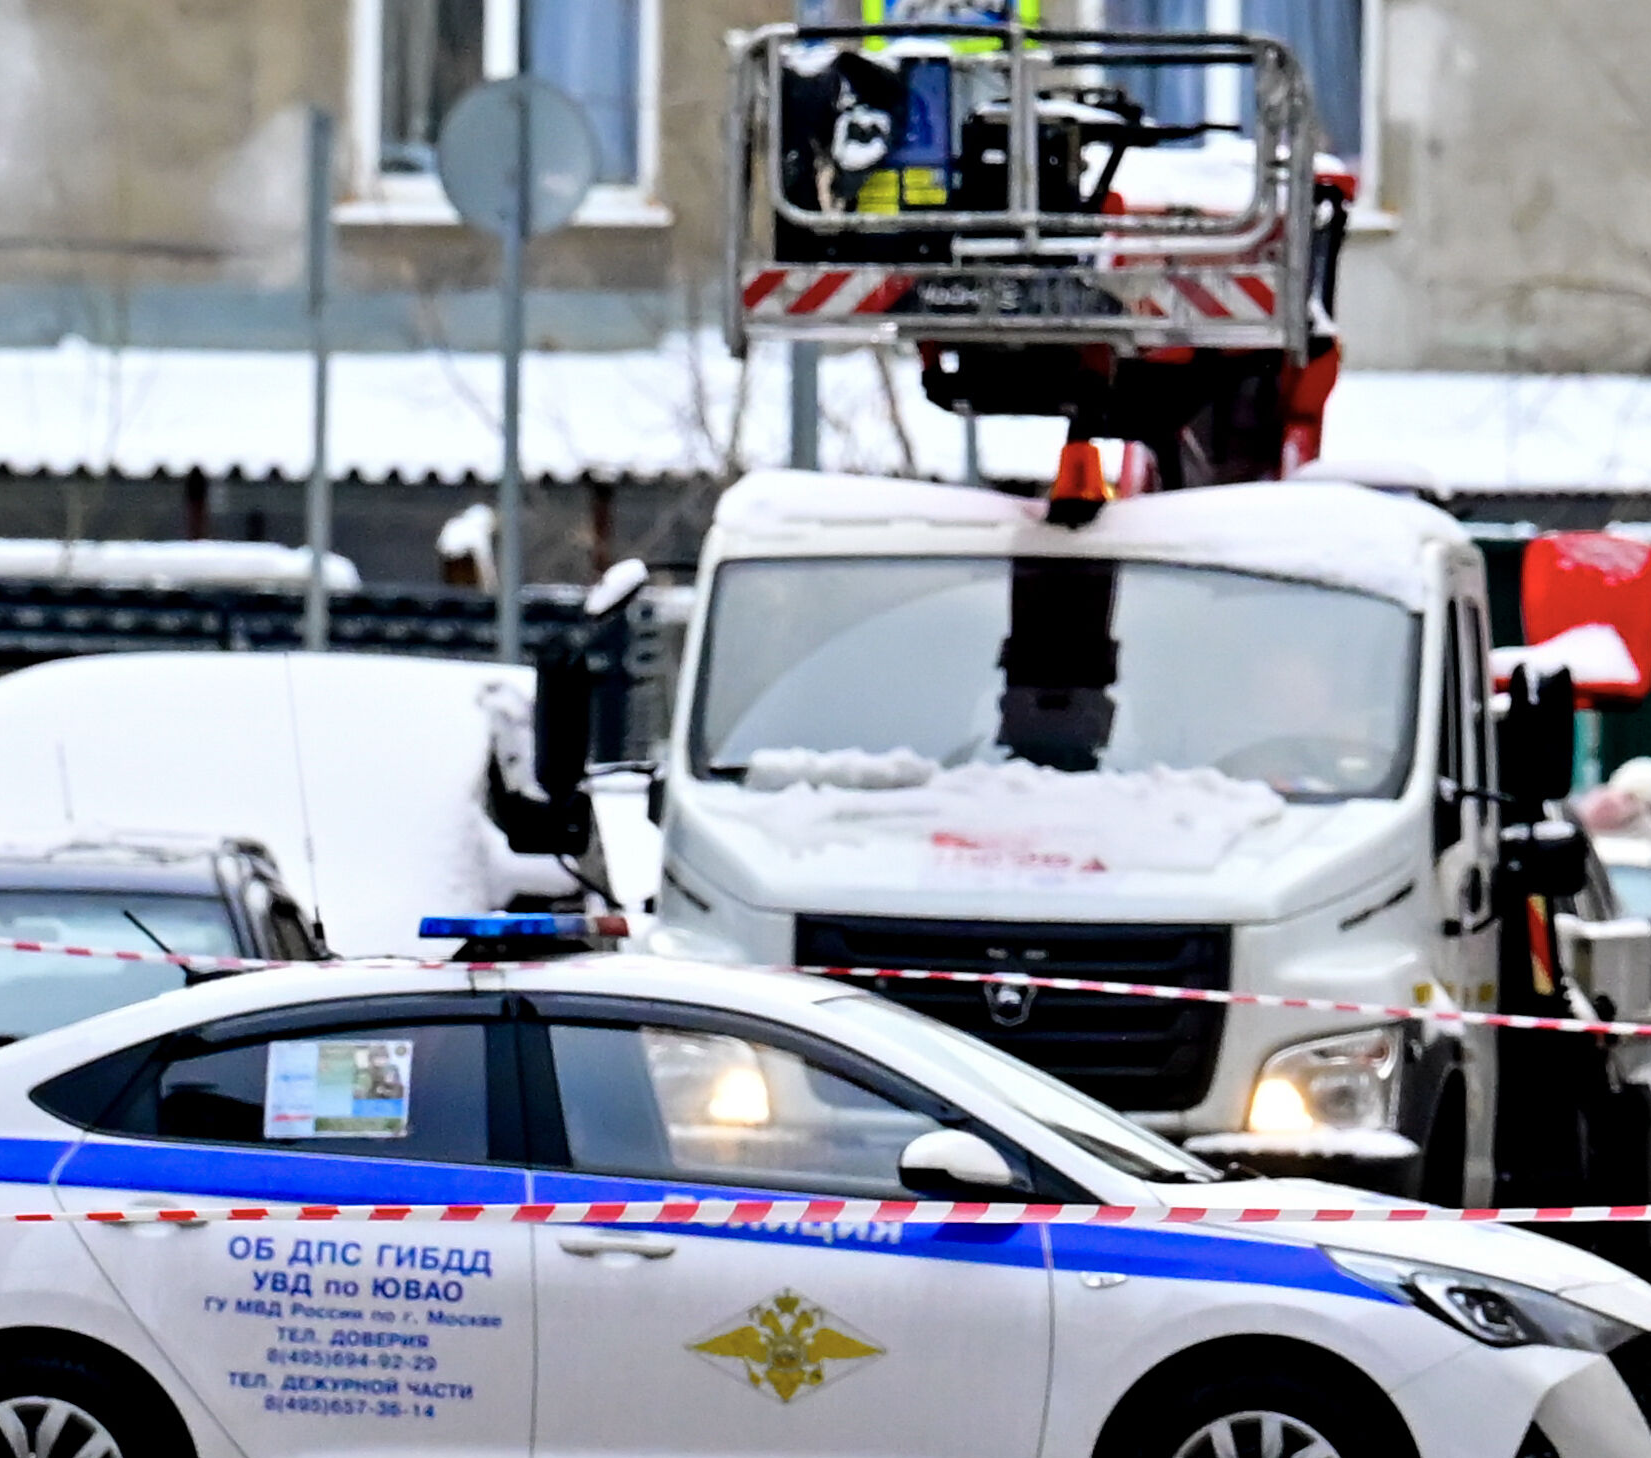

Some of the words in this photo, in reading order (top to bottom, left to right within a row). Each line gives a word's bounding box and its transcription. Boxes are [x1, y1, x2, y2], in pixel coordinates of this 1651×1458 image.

[228, 1236, 276, 1261] ОБ
[287, 1240, 362, 1267] ДПС
[377, 1244, 493, 1278] ГИБДД
[252, 1270, 313, 1298] УВД
[324, 1279, 359, 1297] по
[371, 1277, 464, 1302] ЮВАО
[235, 1299, 283, 1318] МВД
[329, 1329, 430, 1348] ДОВЕРИЯ
[281, 1374, 399, 1396] ДЕЖУРНОЙ
[406, 1382, 474, 1400] ЧАСТИ
